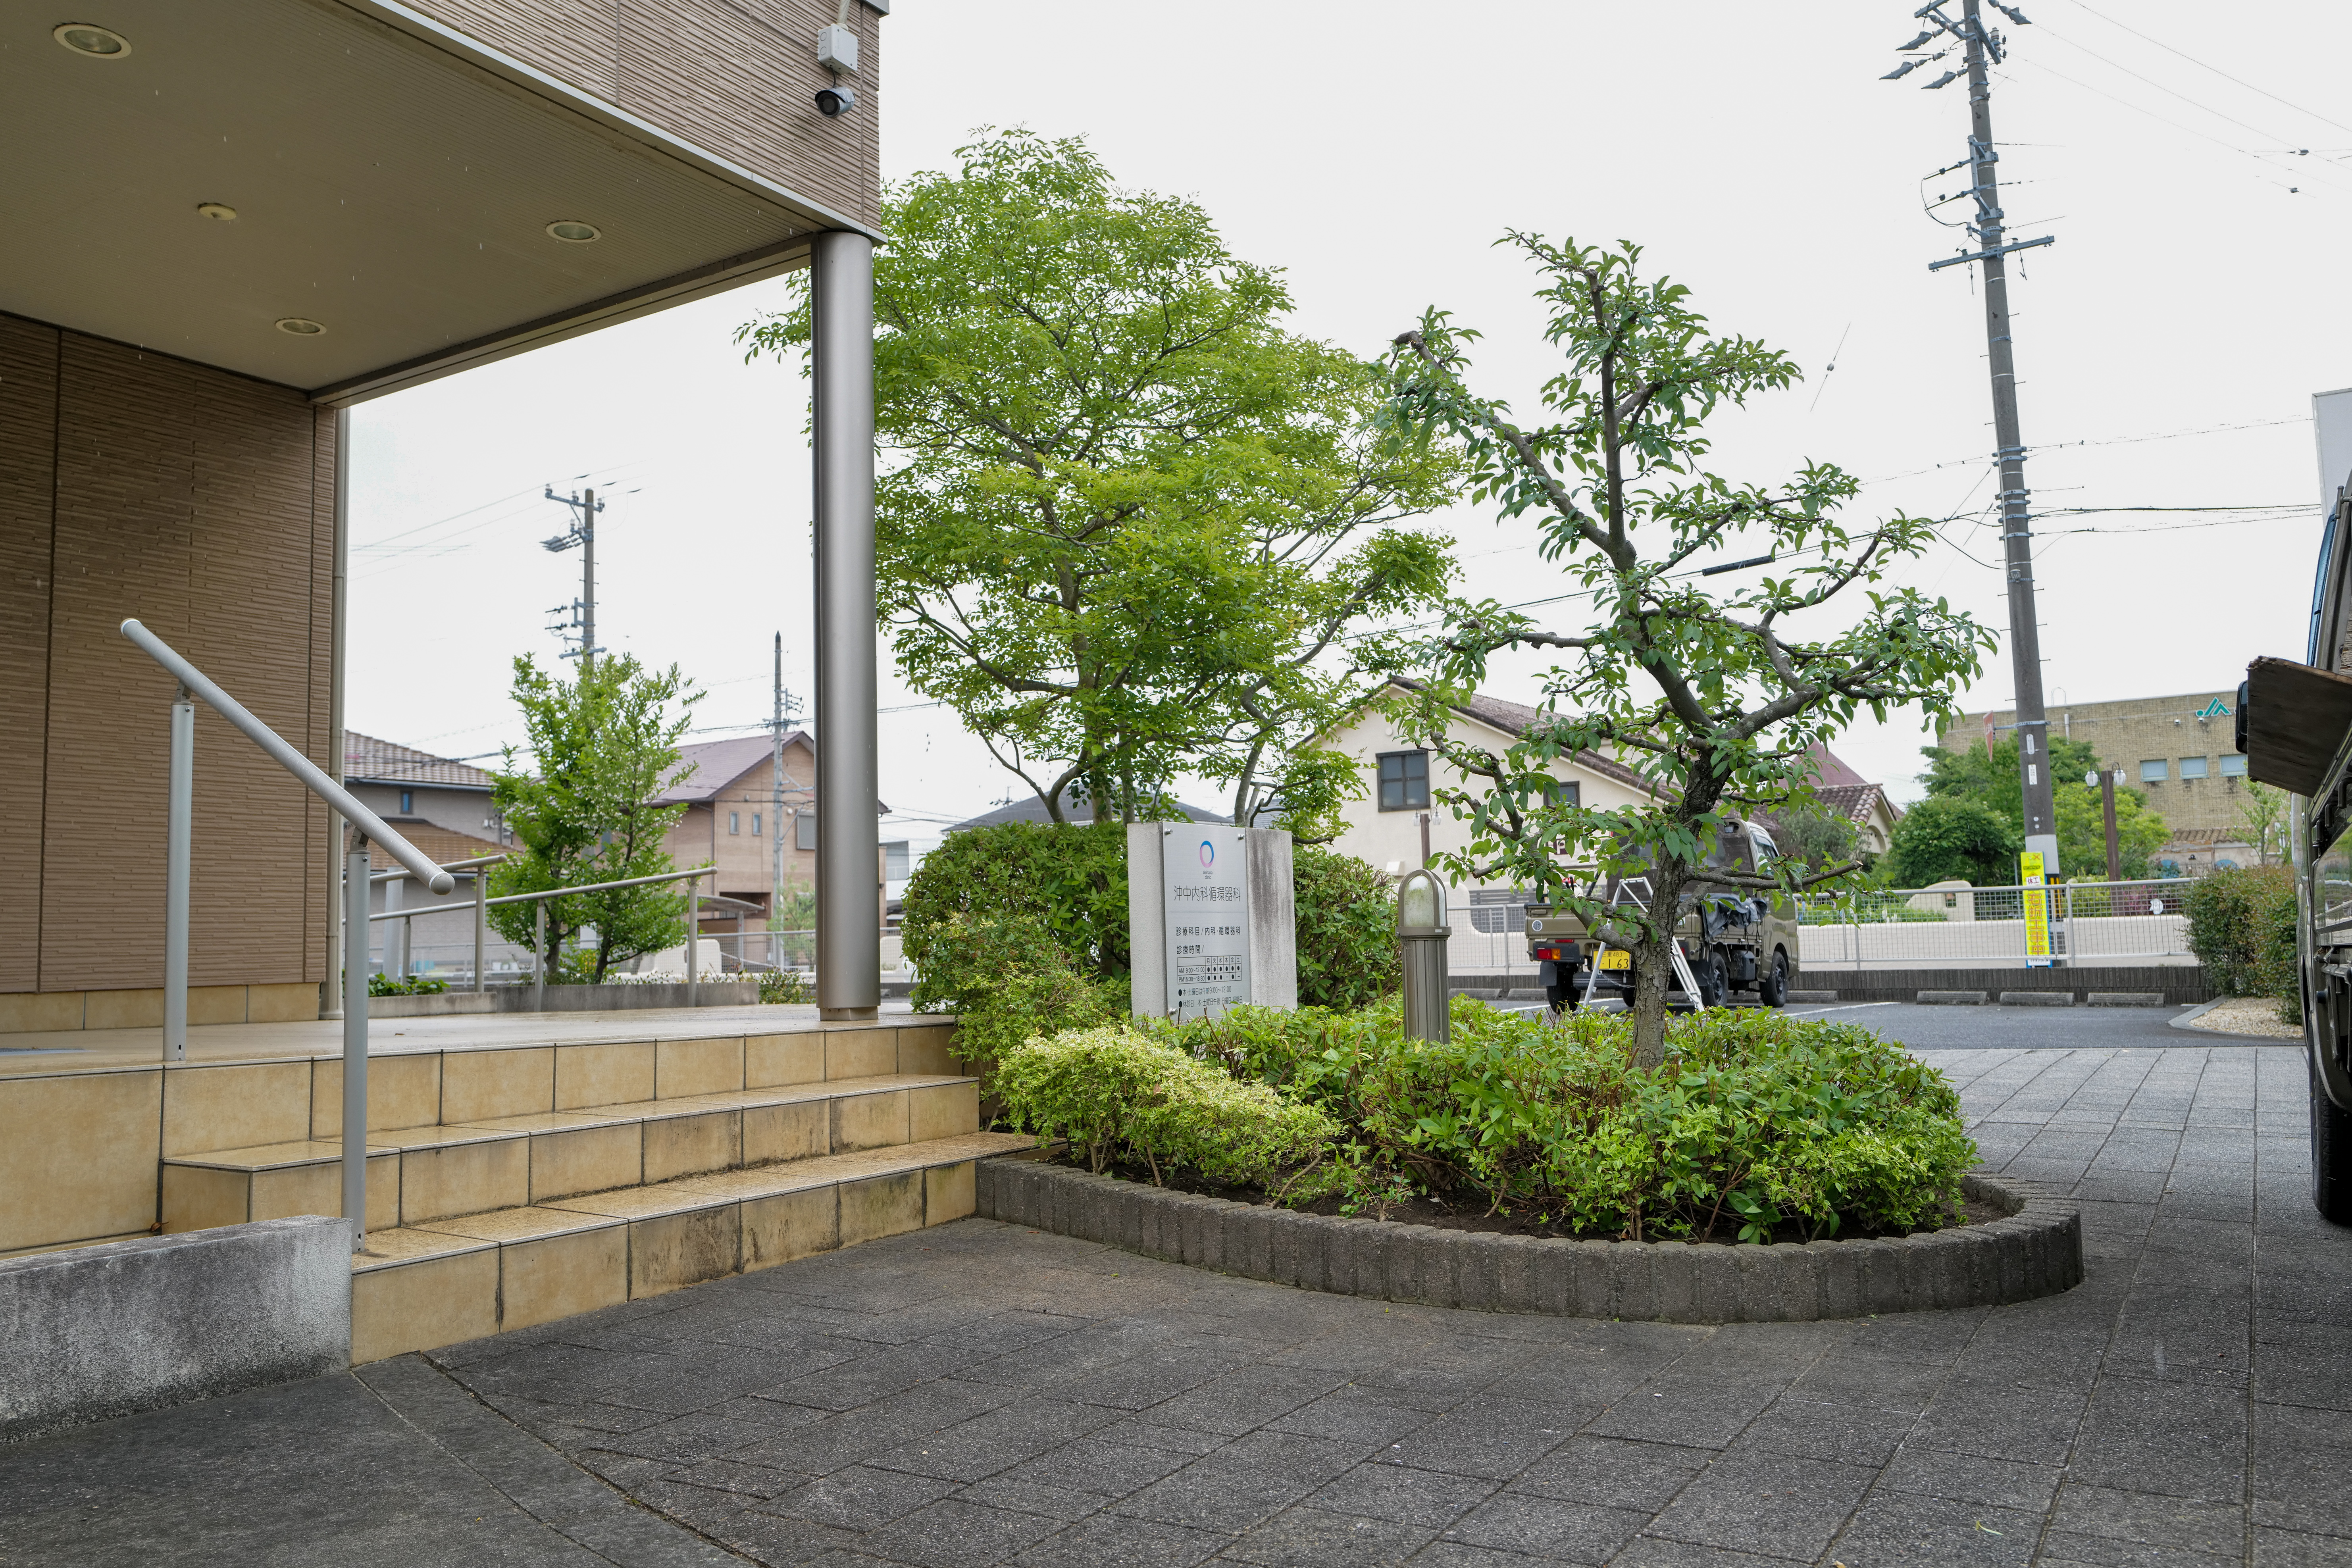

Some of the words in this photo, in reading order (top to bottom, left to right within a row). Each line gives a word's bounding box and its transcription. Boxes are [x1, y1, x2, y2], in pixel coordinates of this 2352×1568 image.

[1174, 885, 1240, 901] 沖中内科循環器科
